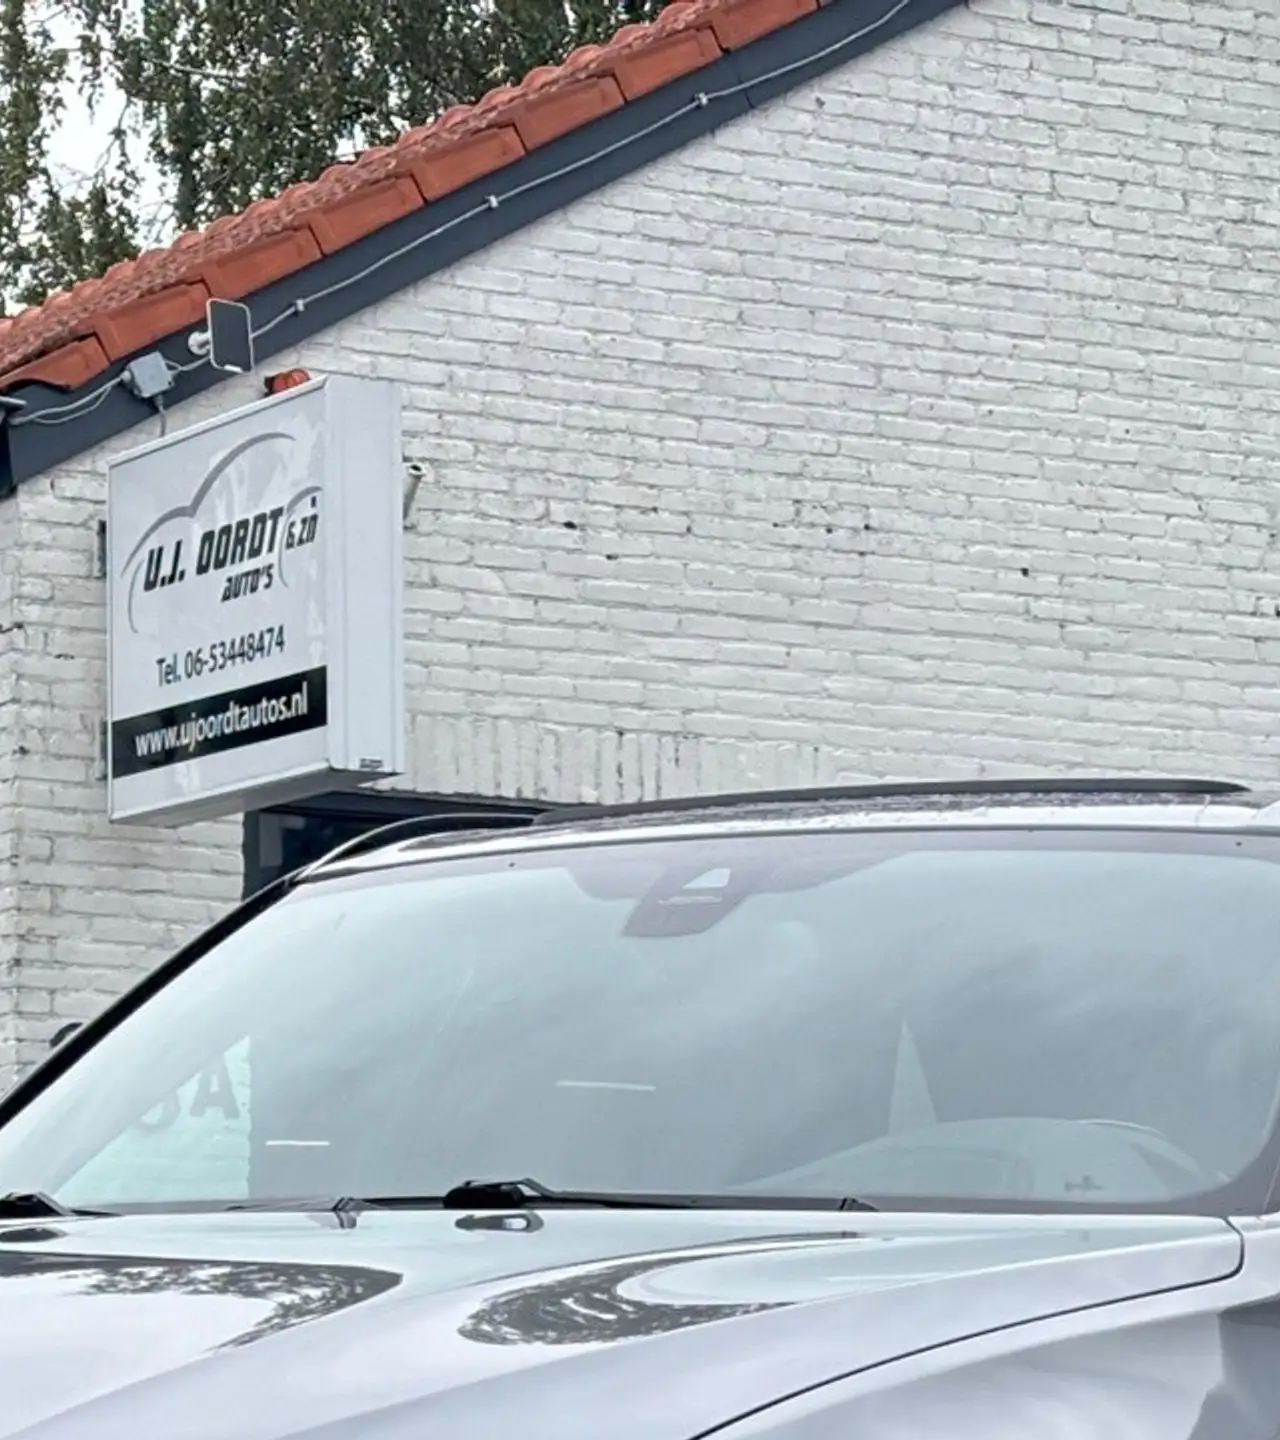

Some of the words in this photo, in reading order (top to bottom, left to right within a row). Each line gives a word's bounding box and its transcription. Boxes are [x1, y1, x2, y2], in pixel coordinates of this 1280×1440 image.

[143, 538, 187, 593] U.J.
[195, 506, 284, 576] OORDT
[156, 653, 182, 686] Tel.
[184, 624, 286, 679] 06-53448474
[135, 681, 308, 757] www.ujoordtautos.nl
